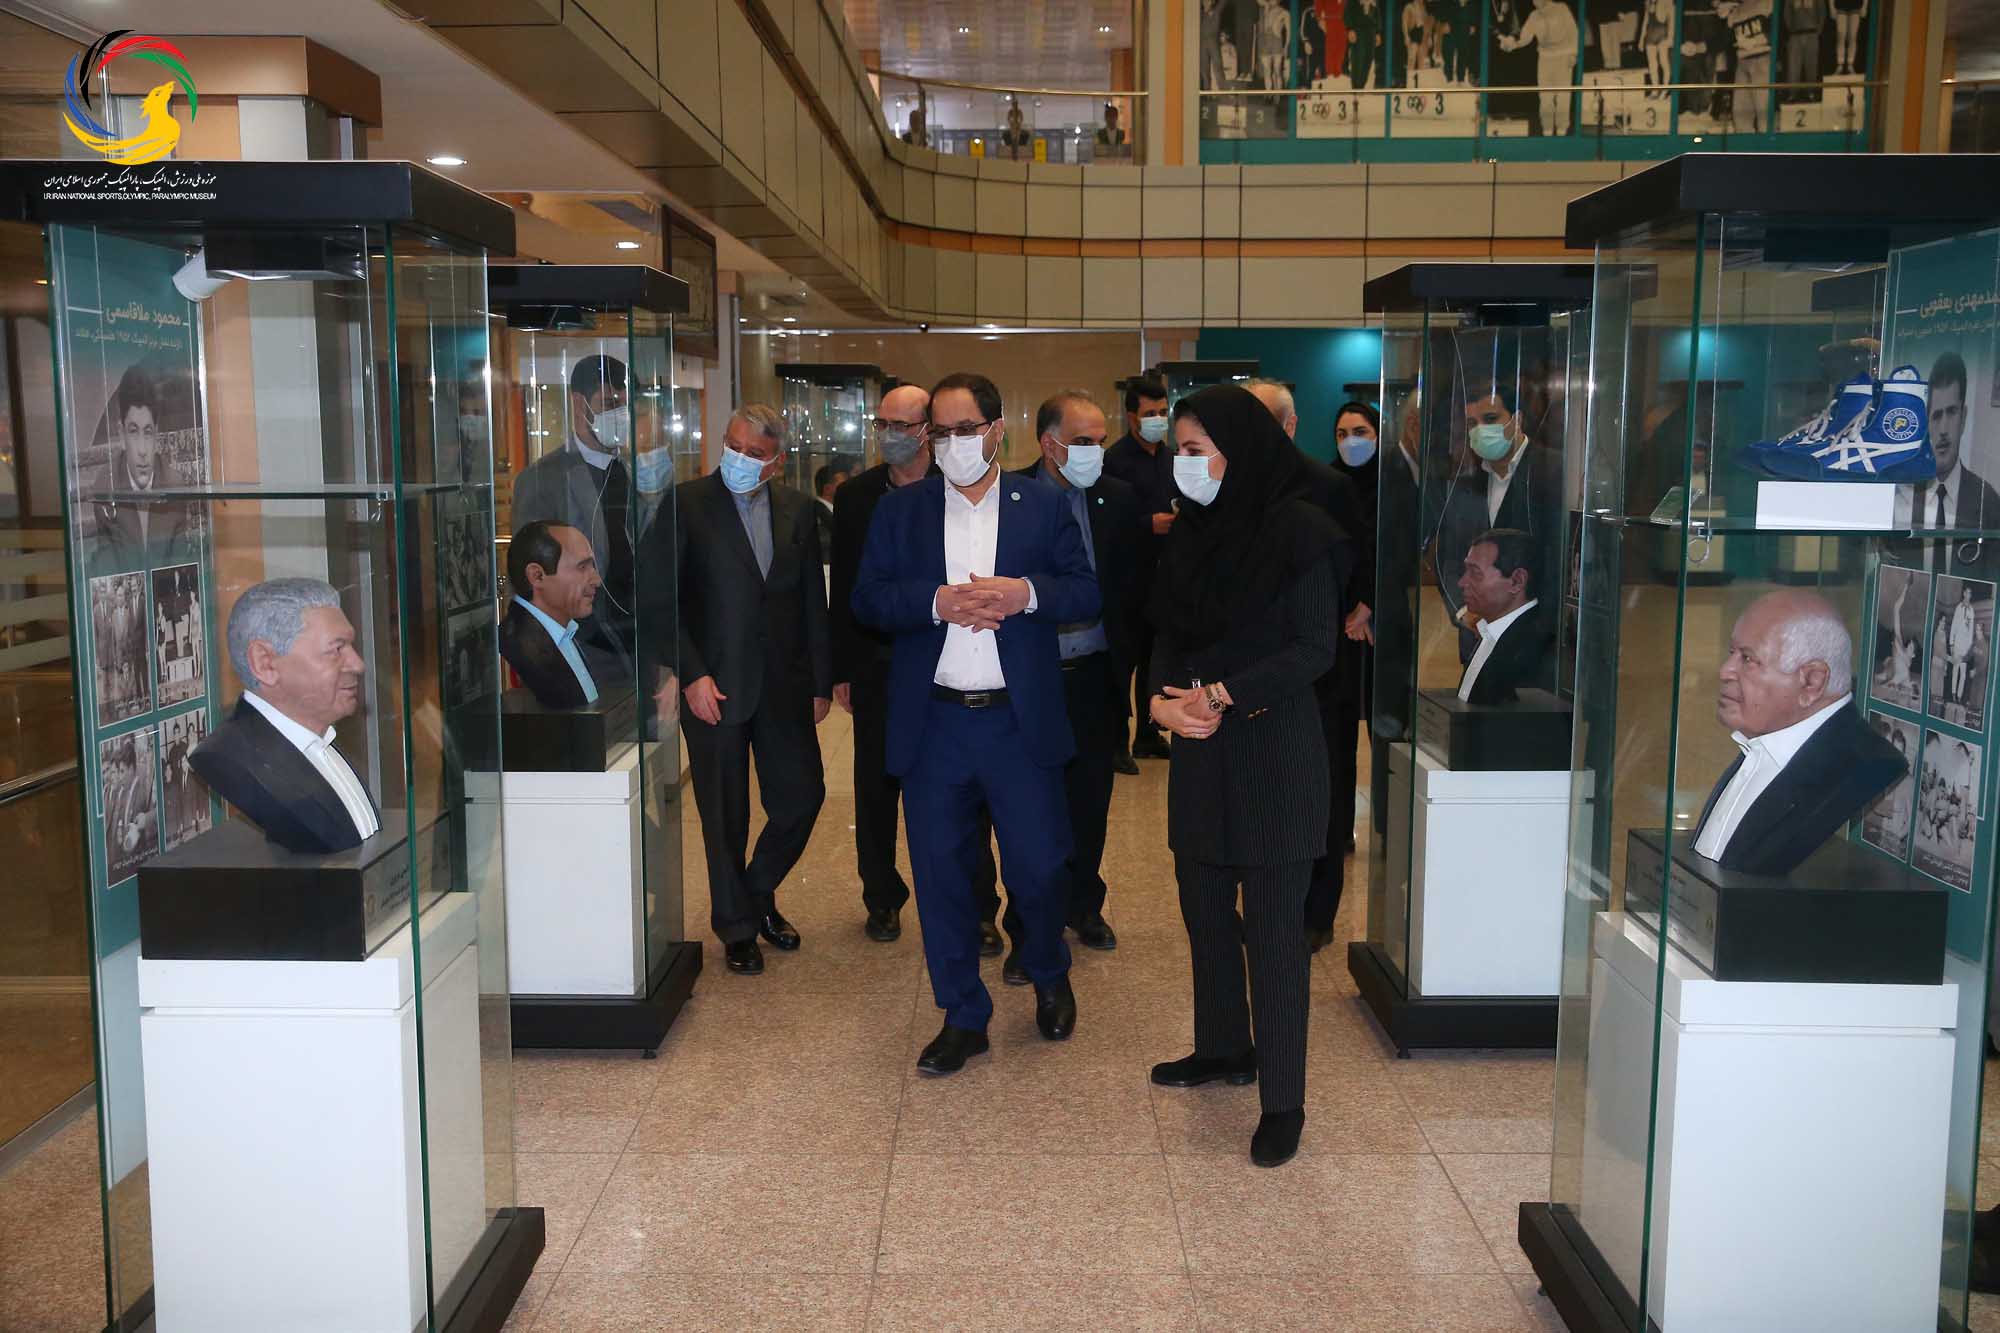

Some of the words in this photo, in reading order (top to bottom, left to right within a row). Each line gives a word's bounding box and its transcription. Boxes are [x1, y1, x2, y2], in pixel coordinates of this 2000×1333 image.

[1338, 100, 1346, 120] 3
[1394, 95, 1401, 114] 2
[1435, 93, 1444, 115] 3
[1646, 107, 1656, 128] 3
[1795, 110, 1807, 128] 2
[1920, 293, 1953, 319] یعقوبی
[153, 308, 181, 329] محمود
